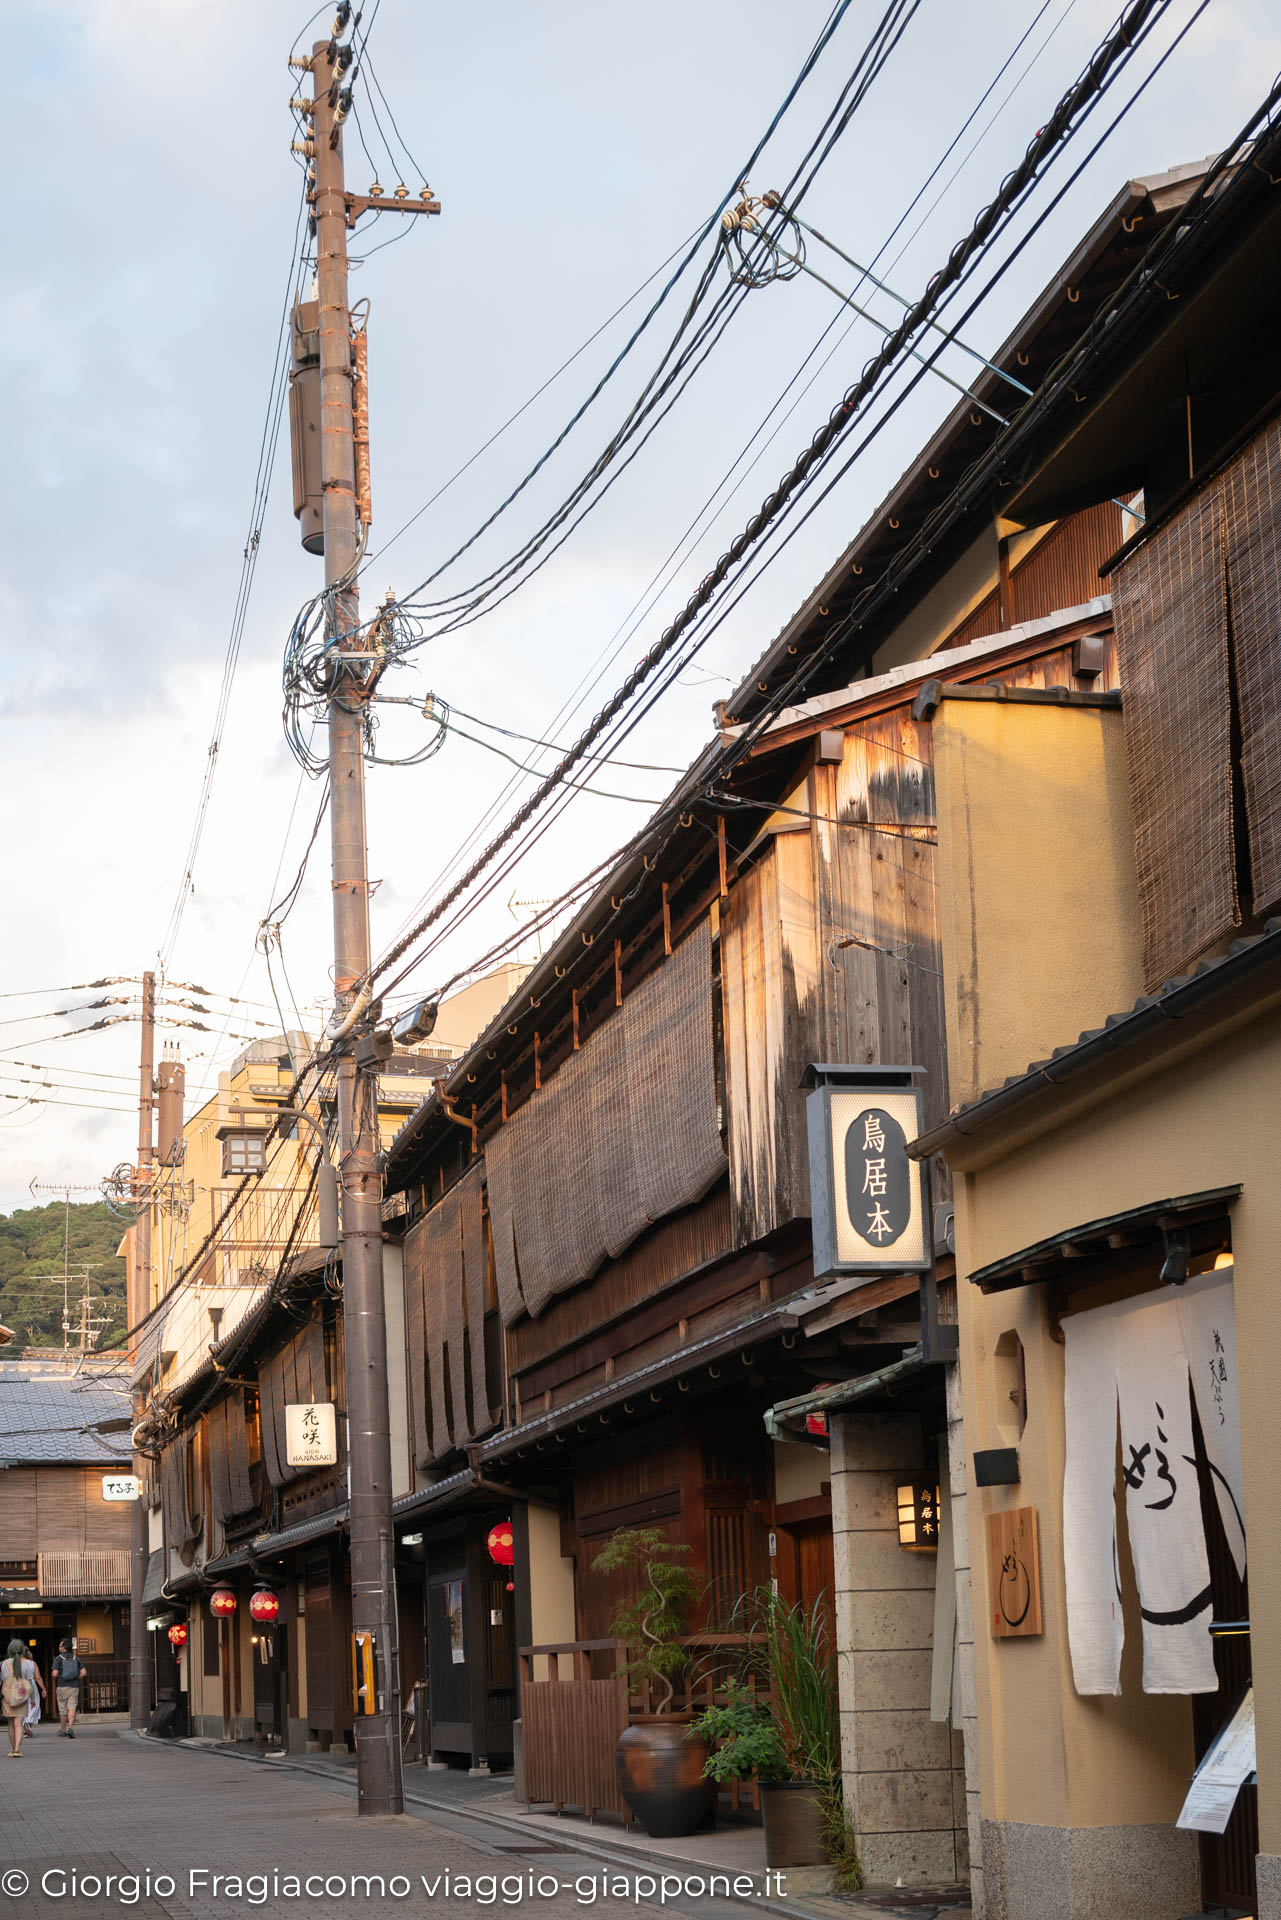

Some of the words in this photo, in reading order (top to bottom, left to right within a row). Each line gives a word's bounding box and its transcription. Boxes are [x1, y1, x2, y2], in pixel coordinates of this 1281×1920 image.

[861, 1113, 894, 1242] 鳥居本
[302, 1407, 322, 1446] 花咲
[292, 1454, 332, 1462] HANASAKI
[107, 1482, 135, 1494] てる子
[921, 1488, 935, 1536] 鳥居本
